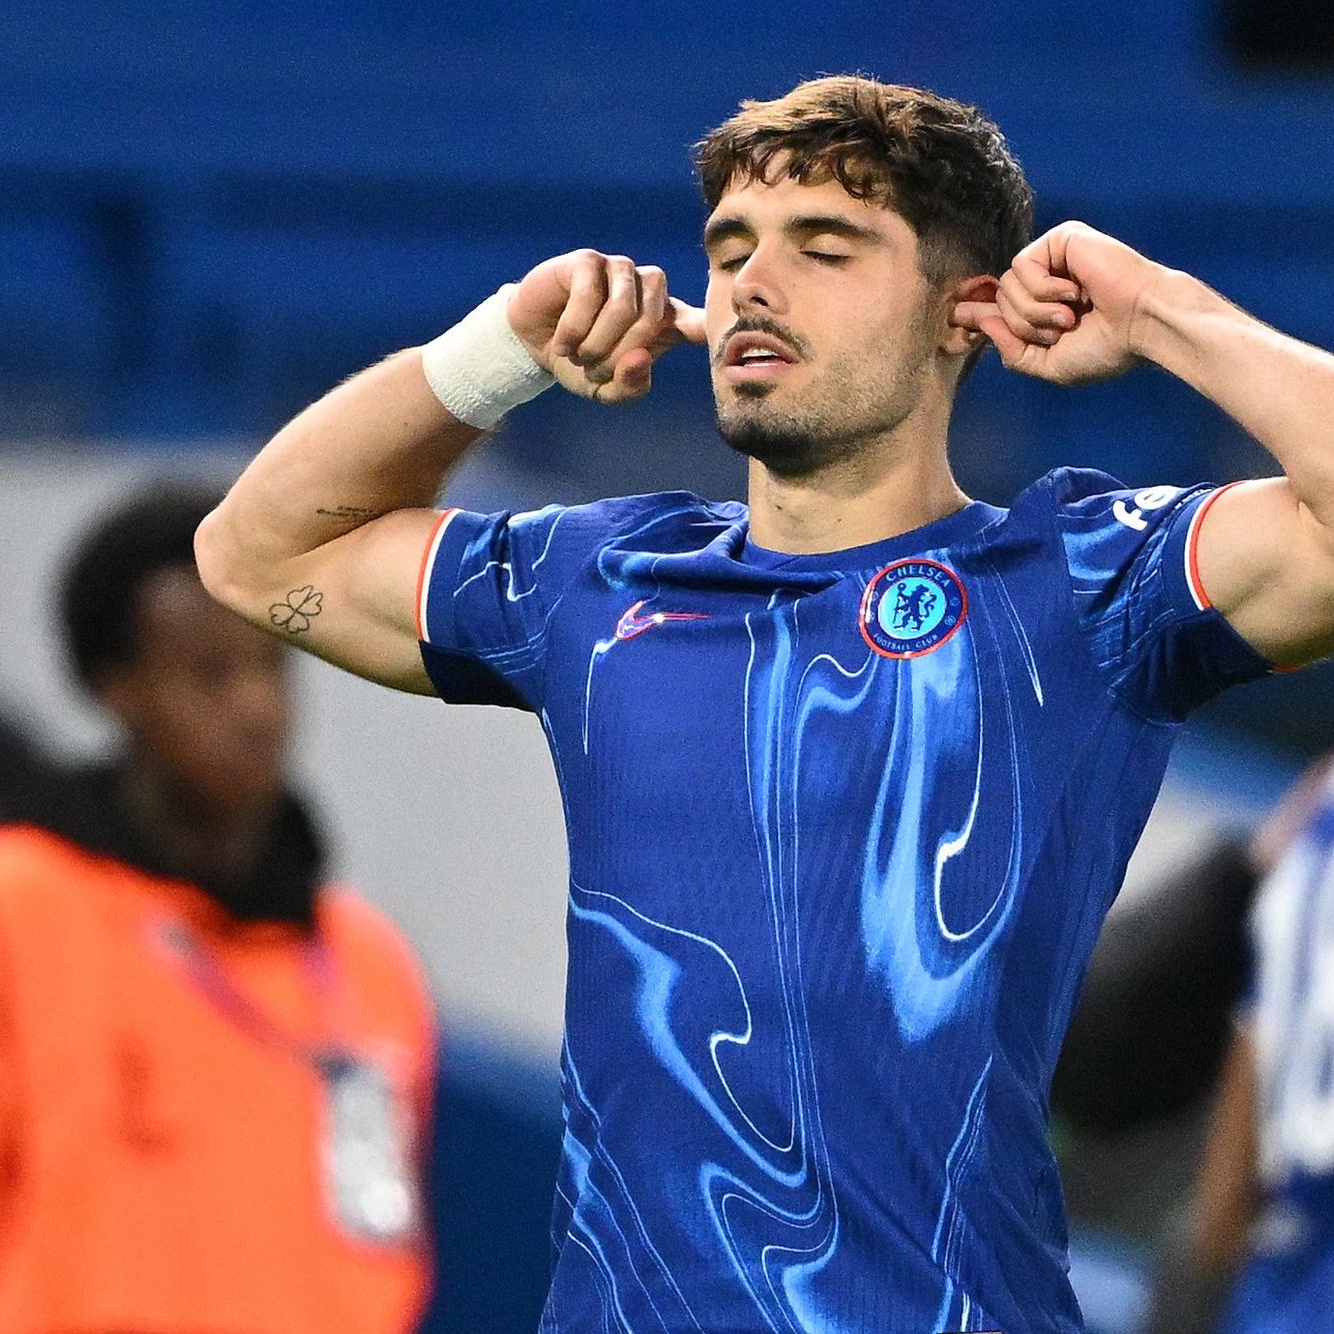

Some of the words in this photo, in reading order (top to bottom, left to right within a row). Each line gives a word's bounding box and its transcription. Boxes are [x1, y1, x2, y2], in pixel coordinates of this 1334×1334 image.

[886, 565, 950, 587] CHELSEA
[873, 633, 910, 650] FOOTBALL
[915, 634, 938, 648] CLUB
